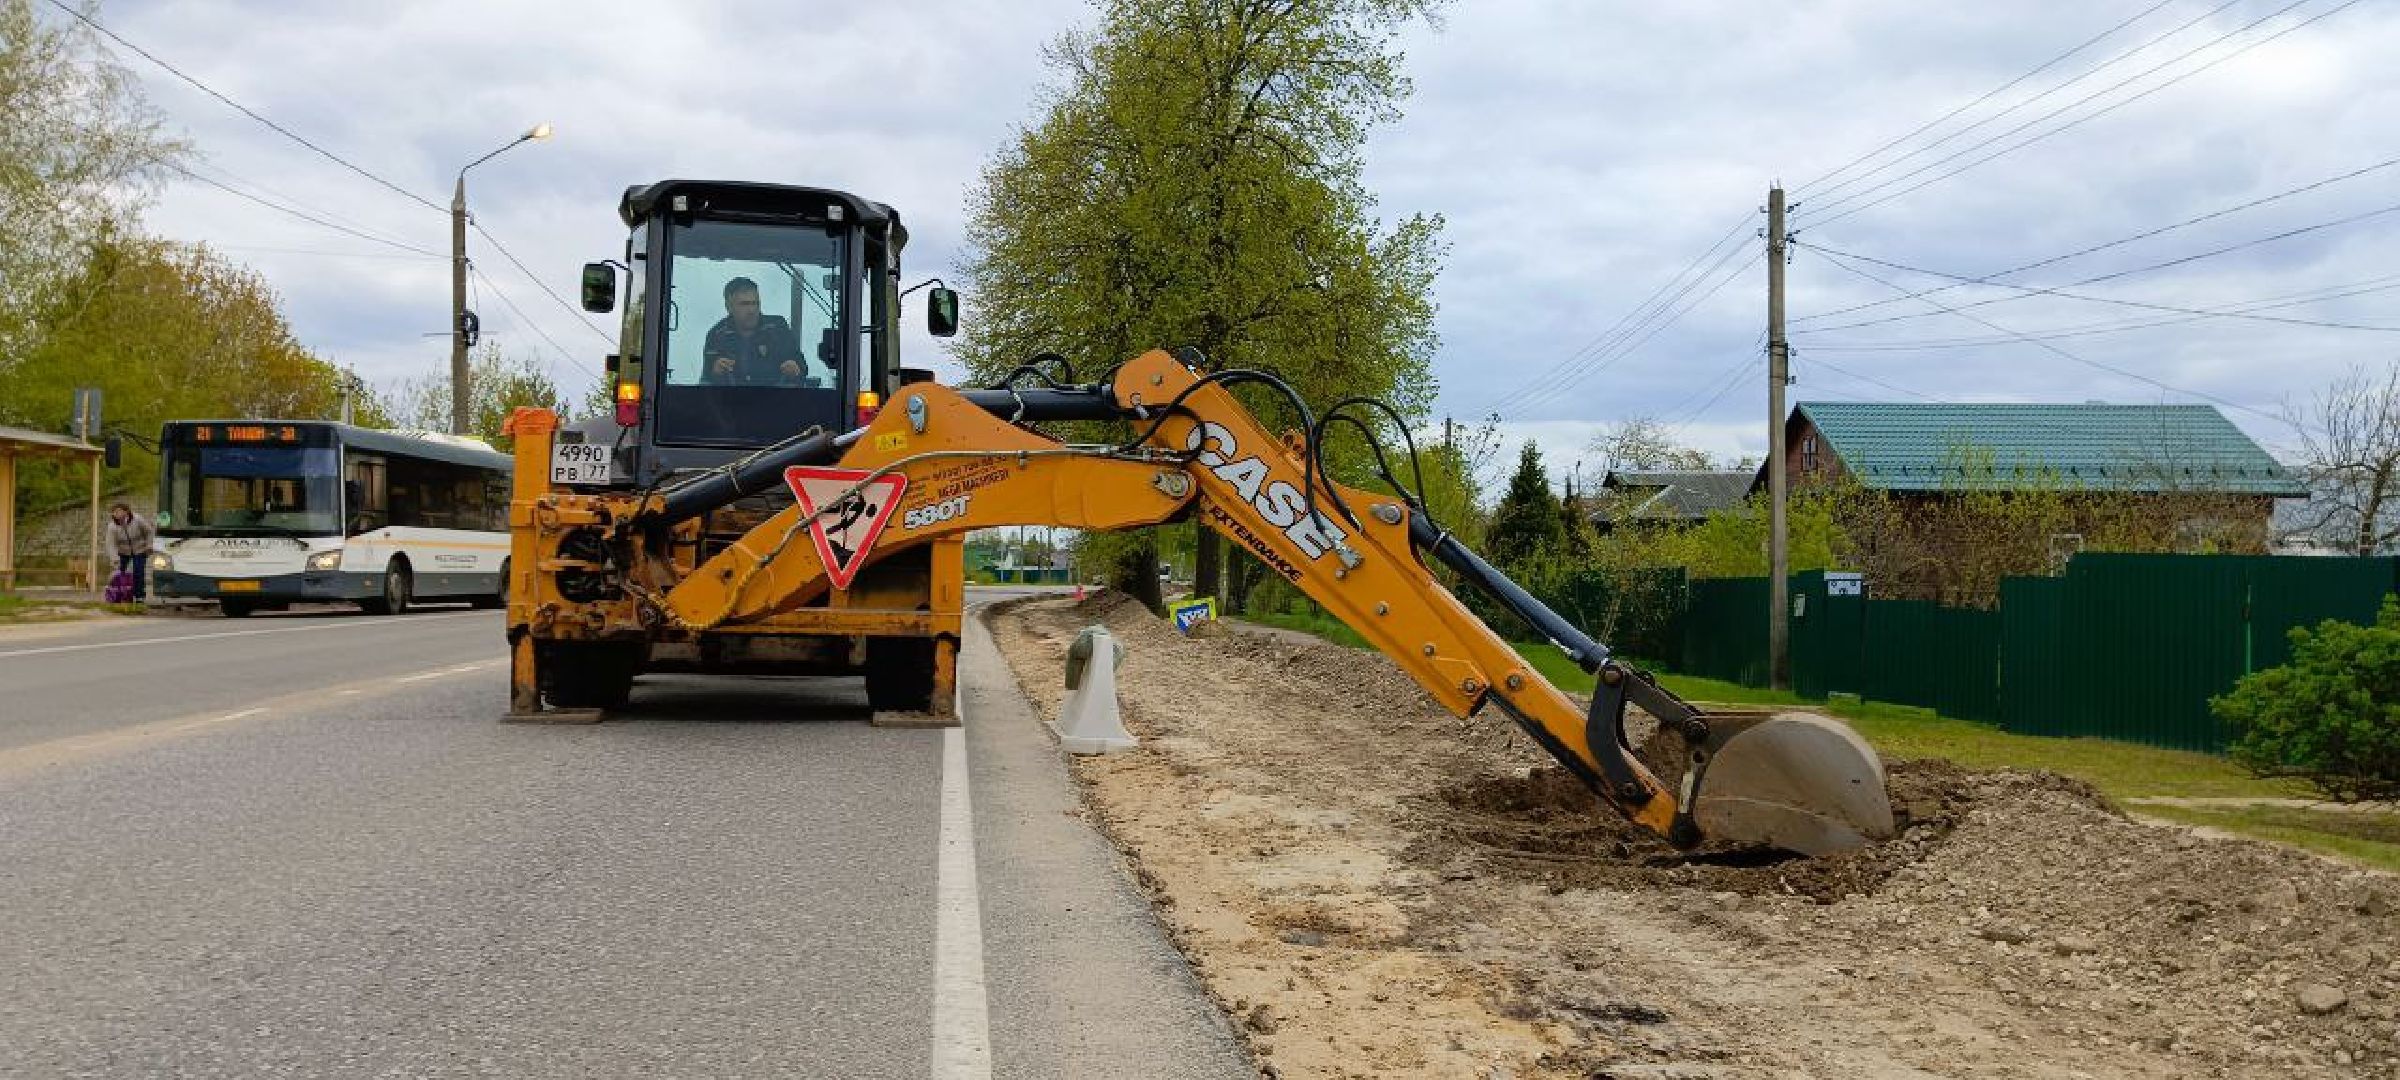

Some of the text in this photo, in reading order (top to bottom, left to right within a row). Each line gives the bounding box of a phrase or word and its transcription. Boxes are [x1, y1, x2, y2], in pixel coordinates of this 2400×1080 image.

[559, 445, 603, 461] 4990
[590, 465, 606, 479] 77
[1187, 421, 1348, 560] CASE
[903, 495, 971, 530] 580T
